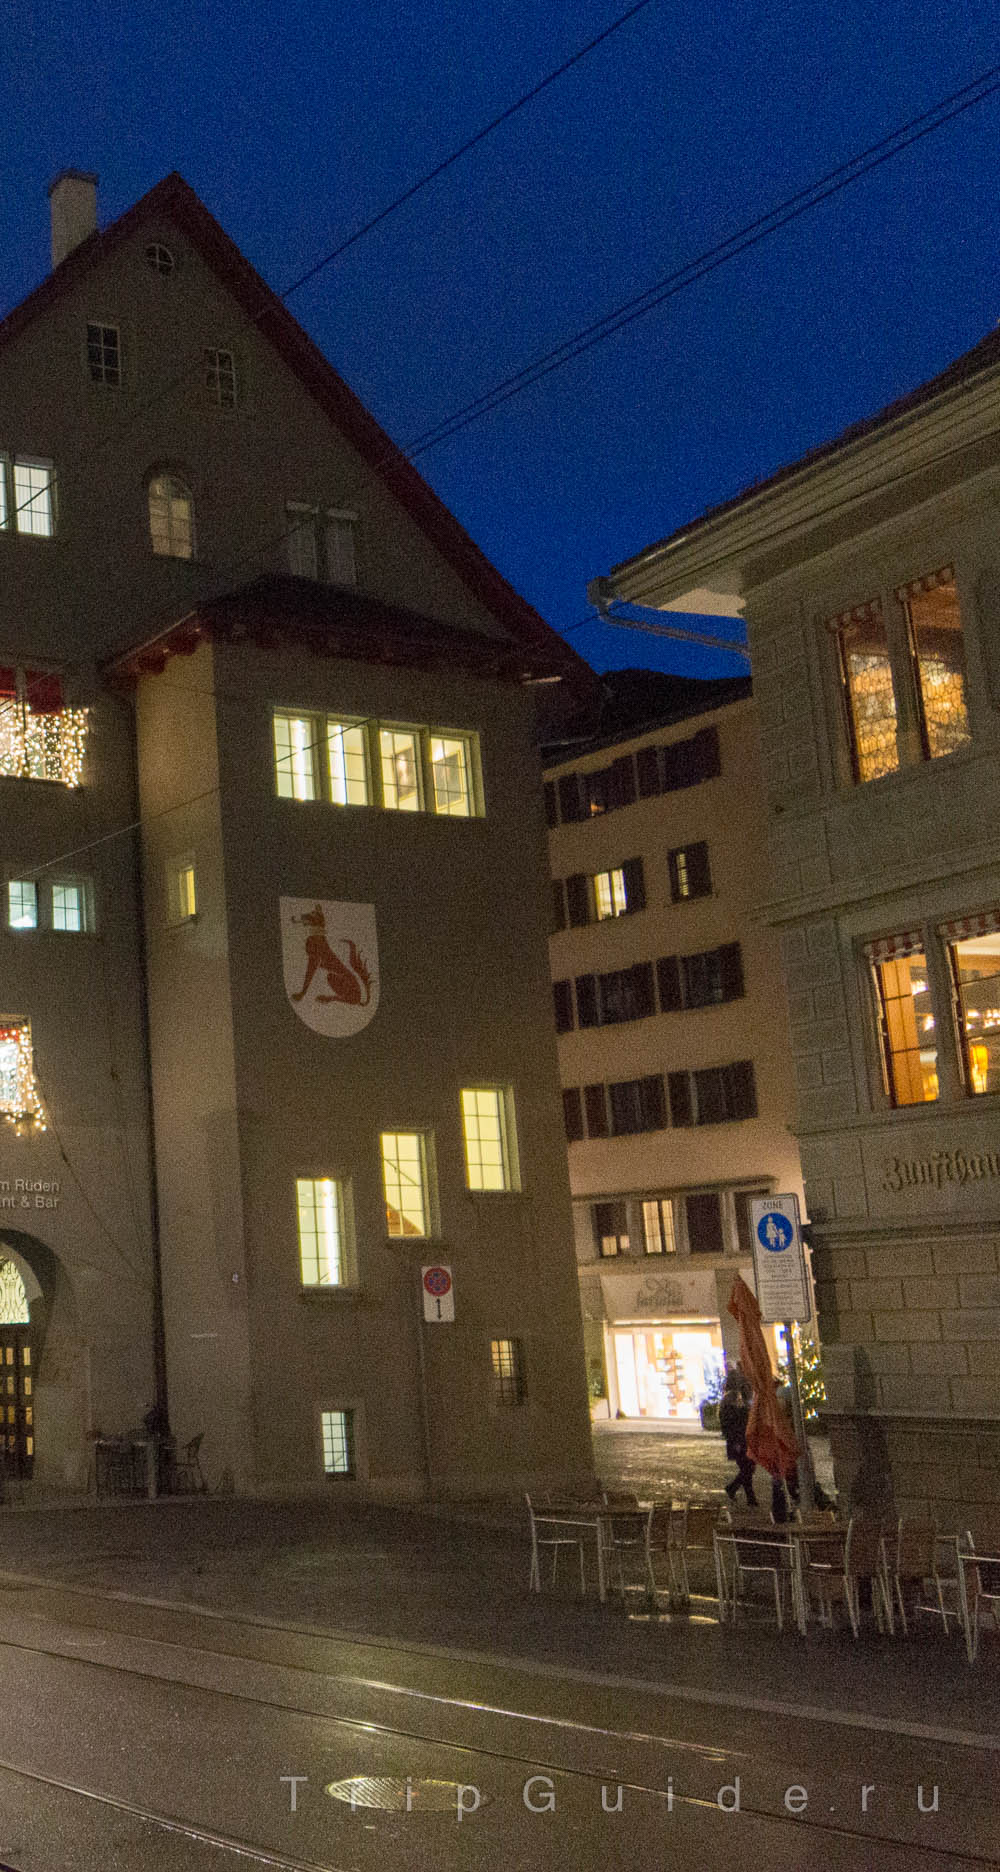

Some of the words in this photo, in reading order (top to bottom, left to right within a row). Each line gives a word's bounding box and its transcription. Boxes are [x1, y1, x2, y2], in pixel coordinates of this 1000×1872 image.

[15, 1178, 60, 1192] Rüden
[21, 1196, 30, 1208] &
[35, 1196, 59, 1208] Bar
[762, 1200, 783, 1210] ZONE
